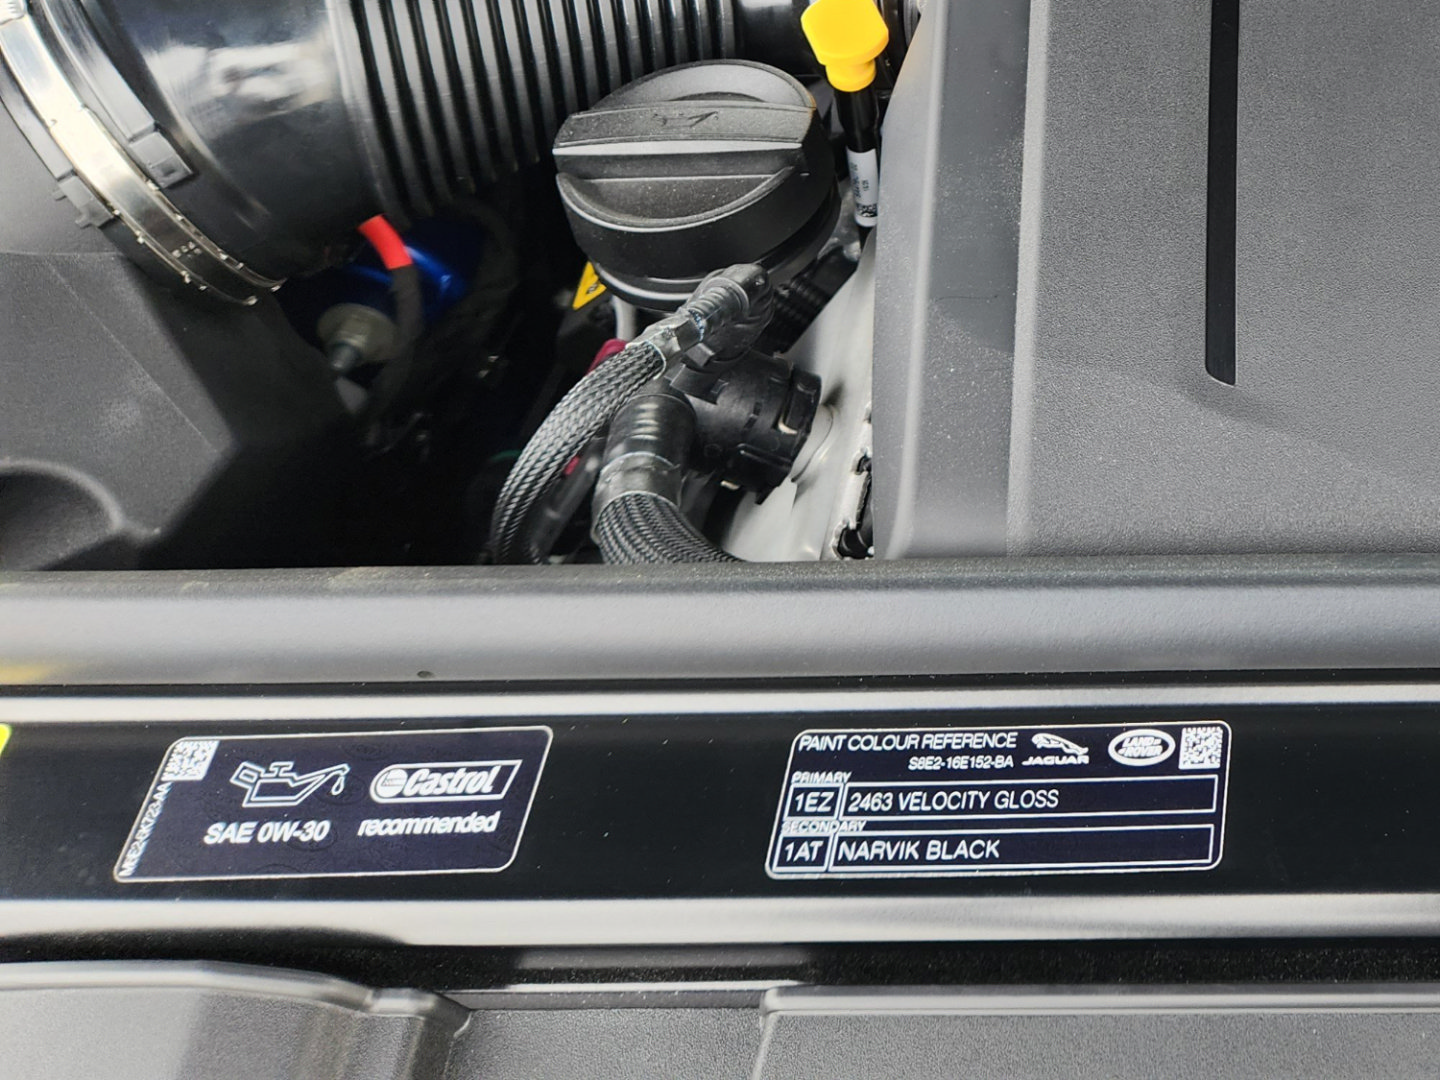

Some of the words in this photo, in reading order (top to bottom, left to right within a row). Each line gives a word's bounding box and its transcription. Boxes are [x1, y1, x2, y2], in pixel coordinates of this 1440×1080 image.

[796, 734, 846, 751] PAINT
[848, 734, 920, 751] COLOUR
[922, 732, 1018, 749] REFERENCE
[908, 755, 1013, 770] S8E2-16E152-BA
[1021, 755, 1089, 766] JAGUAR
[403, 765, 501, 796] Castrol
[790, 771, 852, 784] PRIMARY
[796, 794, 834, 812] 1EZ
[848, 794, 893, 812] 2463
[899, 791, 990, 811] VELOCITY
[995, 789, 1058, 809] GLOSS
[203, 822, 253, 845] SAE
[256, 820, 331, 843] 0W-30
[357, 811, 501, 836] recommended
[780, 821, 866, 834] SECONDARY
[786, 842, 823, 861] 1AT
[837, 841, 919, 861] NARVIK
[926, 840, 999, 860] BLACK
